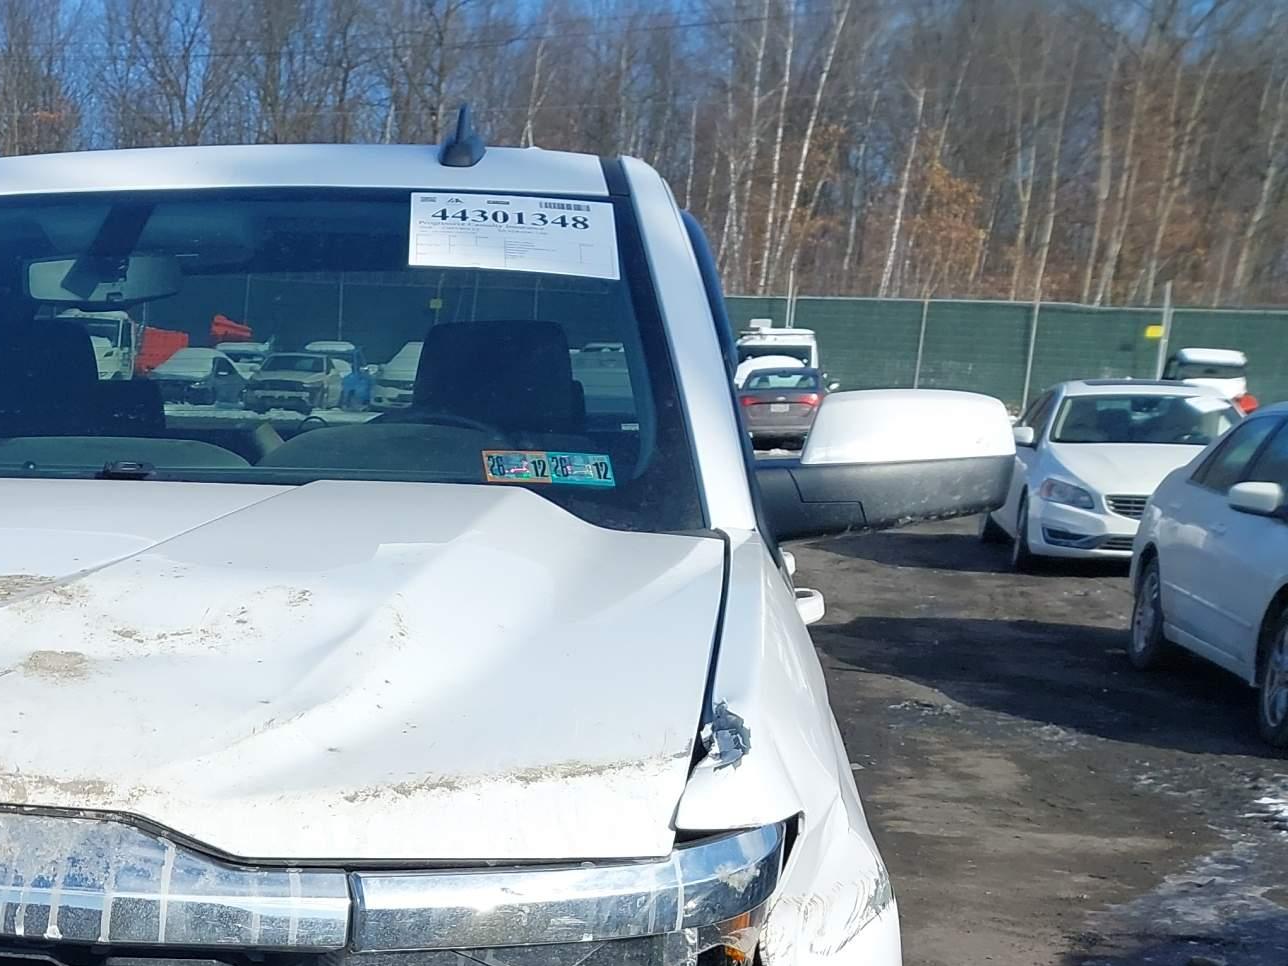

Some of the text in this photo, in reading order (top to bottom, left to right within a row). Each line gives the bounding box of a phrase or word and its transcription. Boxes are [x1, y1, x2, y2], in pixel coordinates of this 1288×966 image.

[431, 207, 590, 230] 44301348
[487, 455, 550, 478] 26 12
[592, 461, 612, 480] 12
